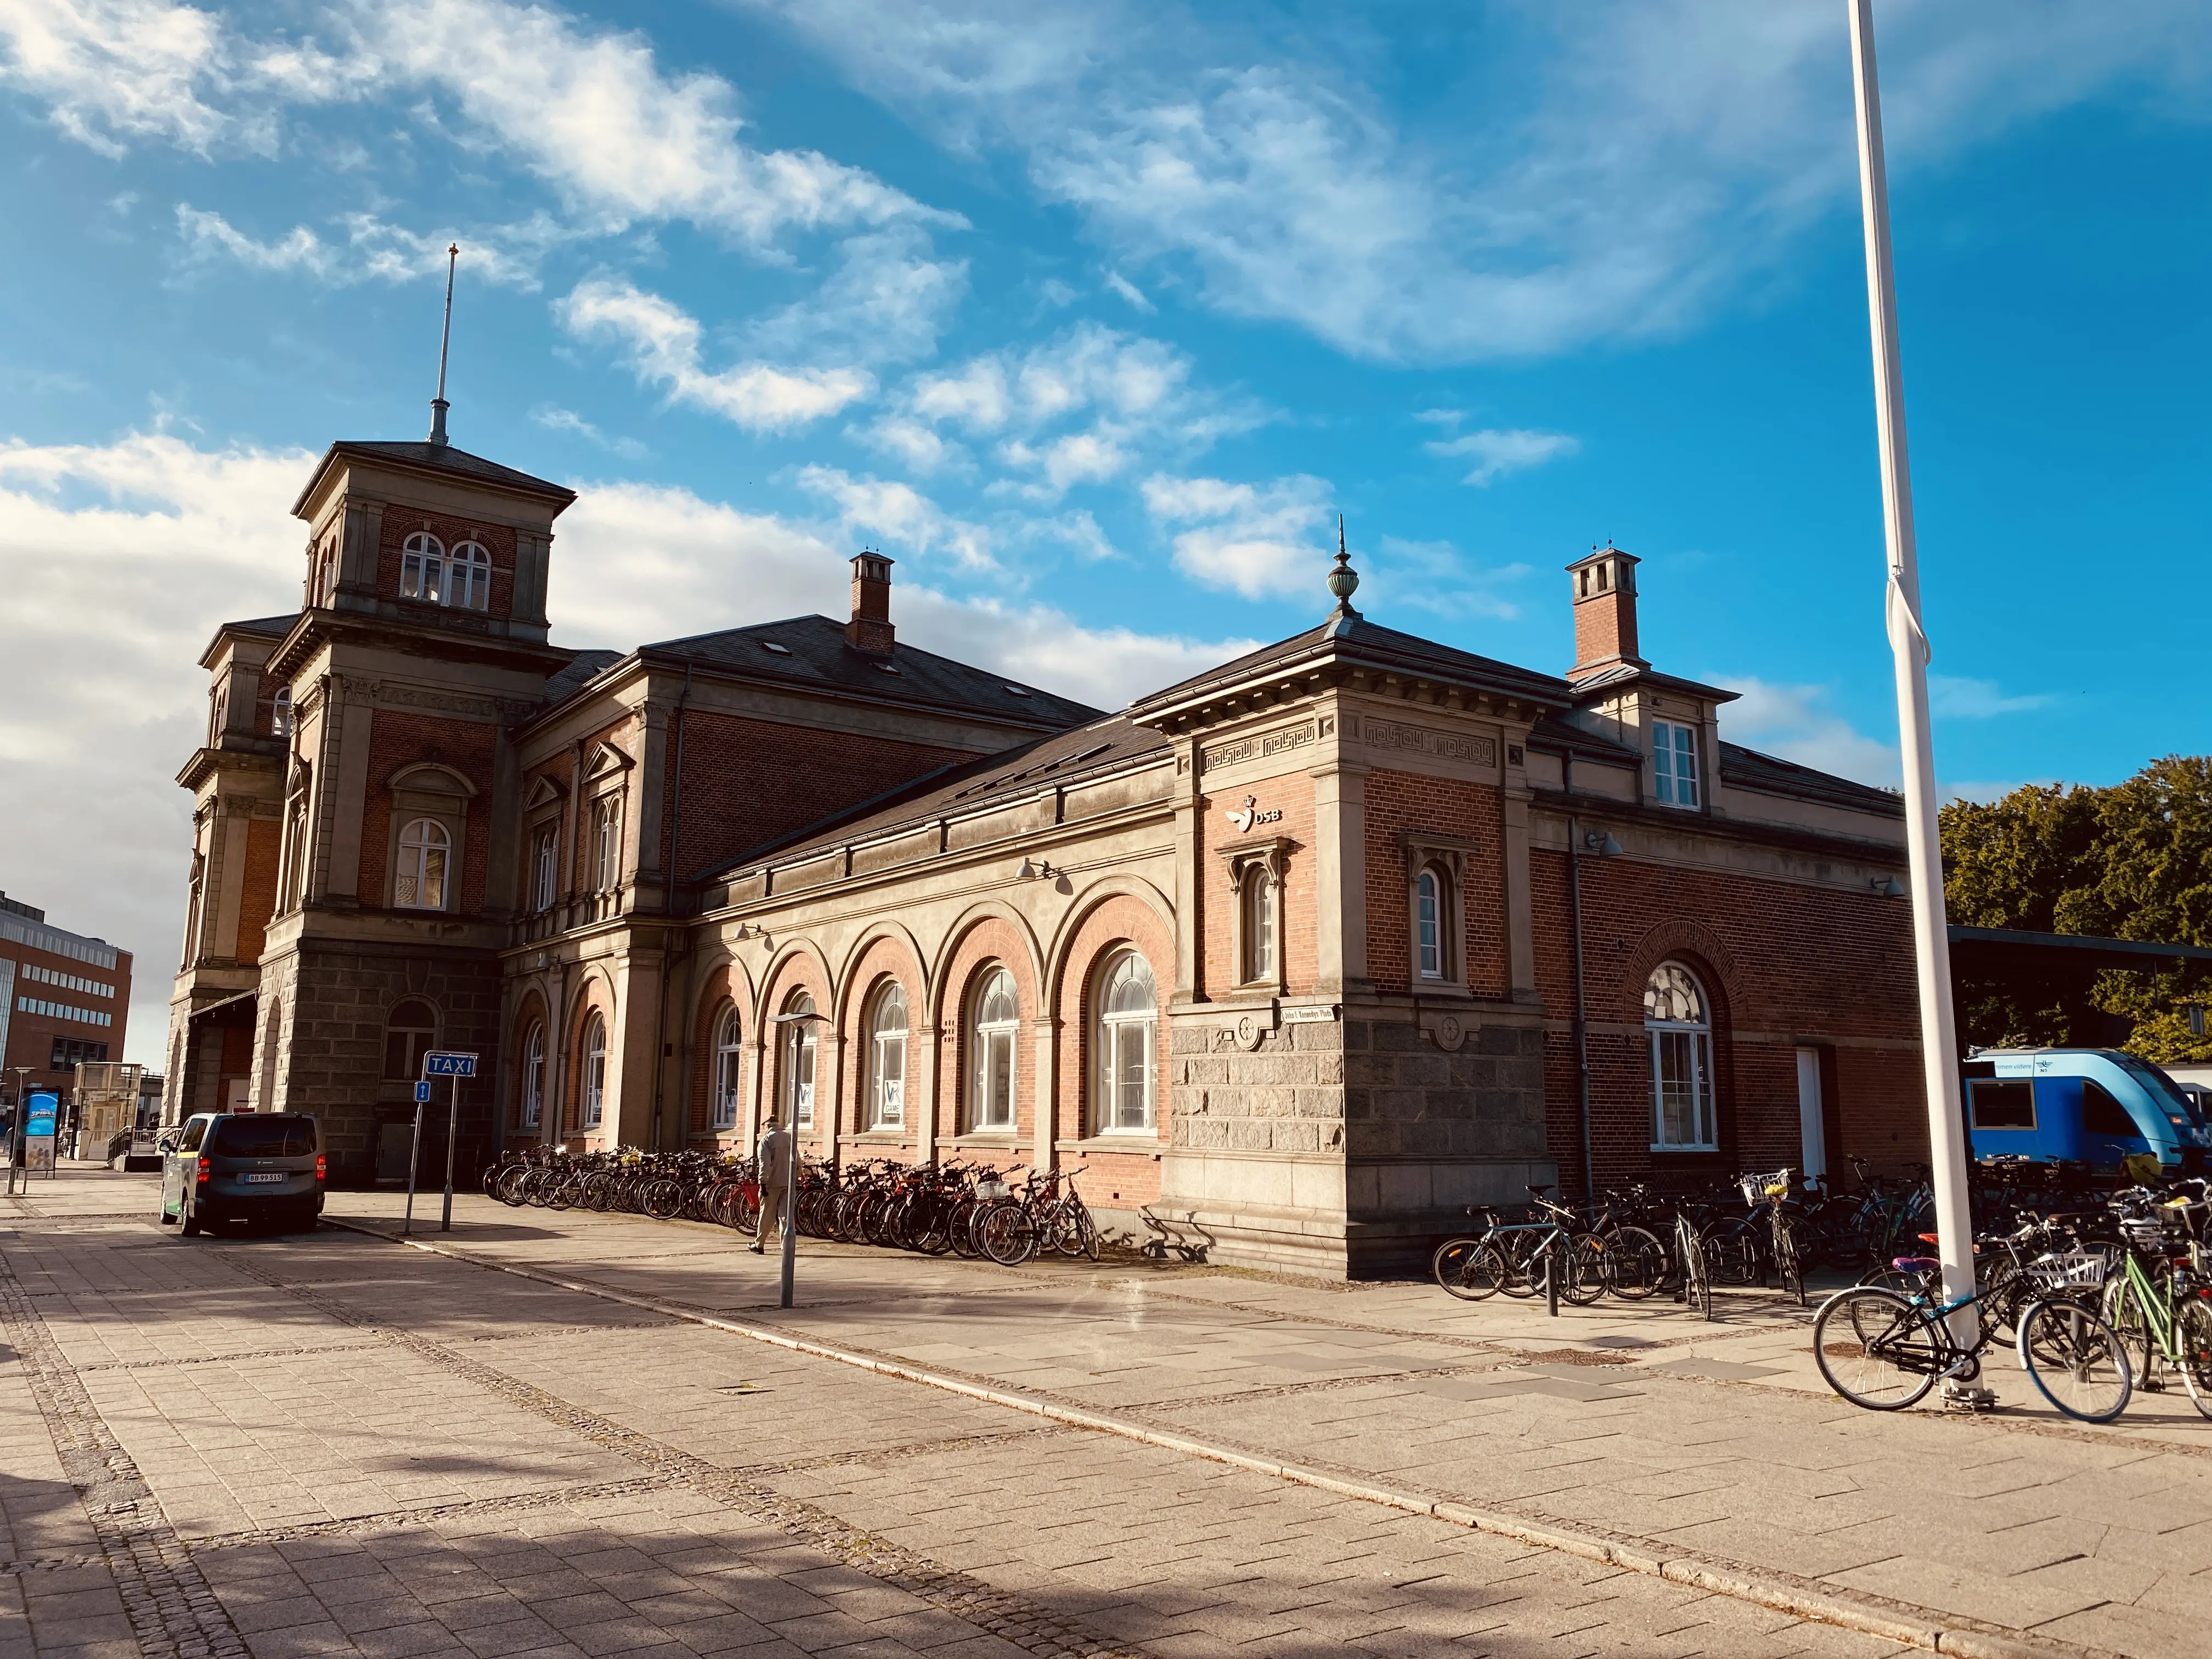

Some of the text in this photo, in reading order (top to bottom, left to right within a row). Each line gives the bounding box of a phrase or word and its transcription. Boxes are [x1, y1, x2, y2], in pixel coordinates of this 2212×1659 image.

[1255, 809, 1280, 824] DSB
[1285, 1011, 1295, 1019] John
[1299, 1009, 1319, 1019] Kennedys
[1319, 1009, 1332, 1017] Plads
[432, 1058, 471, 1073] TAXI
[886, 1081, 901, 1103] VR
[885, 1104, 900, 1113] GAME
